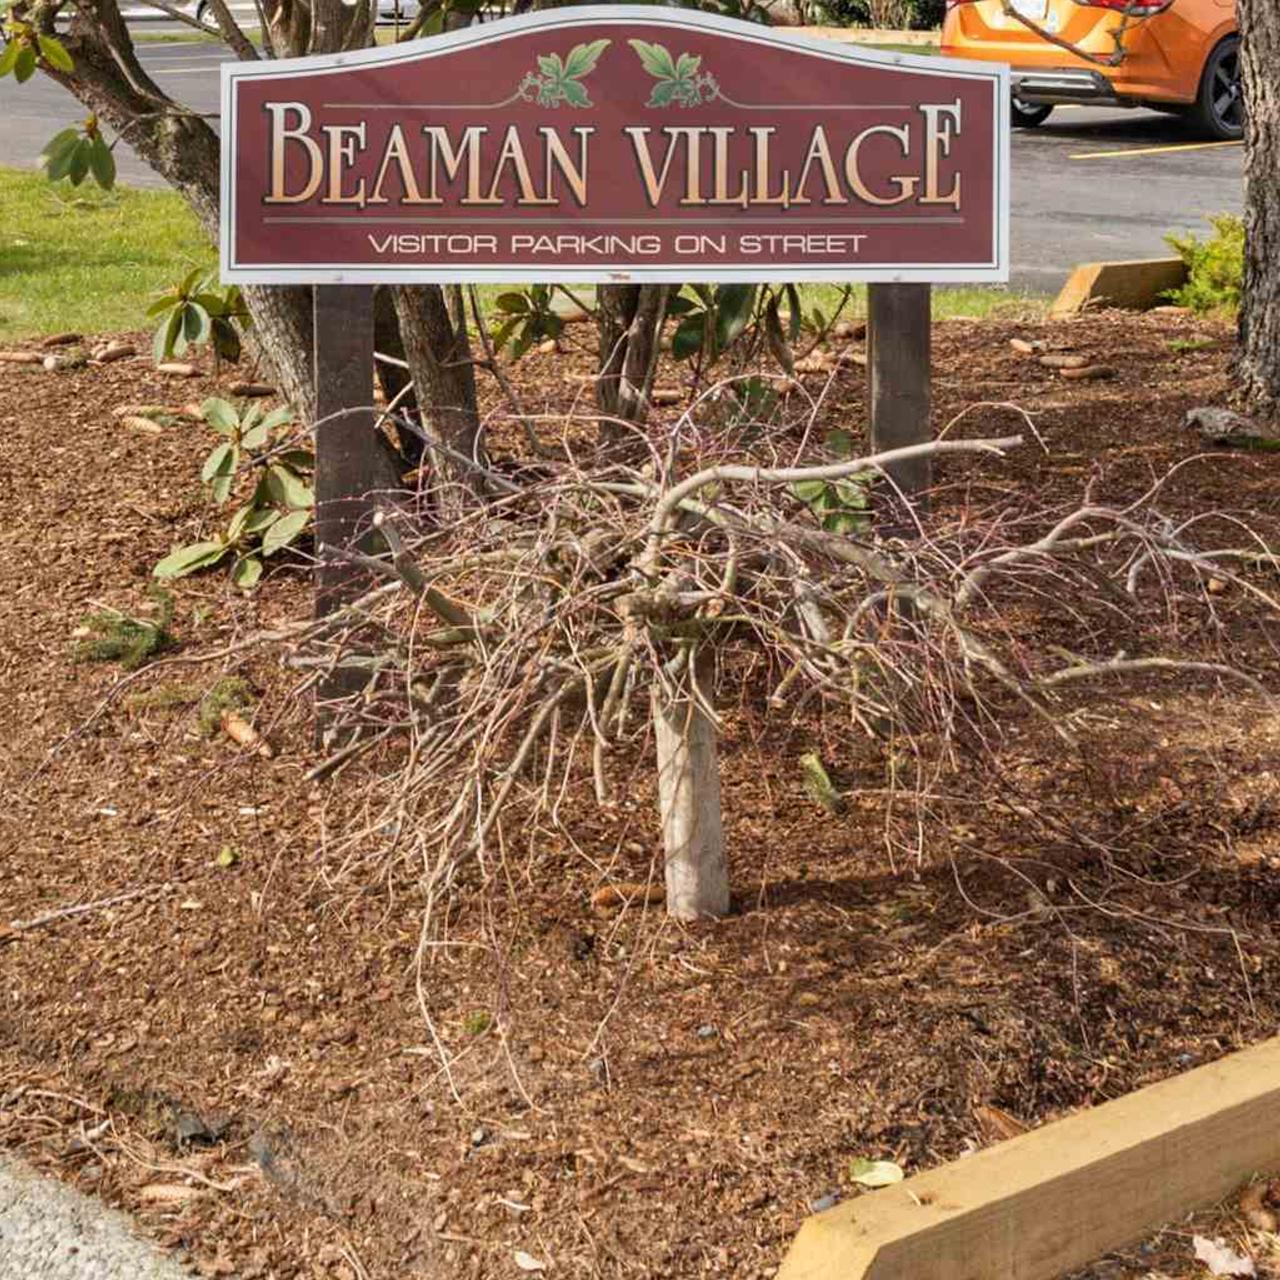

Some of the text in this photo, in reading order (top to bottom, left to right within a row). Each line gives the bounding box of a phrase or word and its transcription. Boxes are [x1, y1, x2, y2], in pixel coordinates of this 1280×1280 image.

[263, 97, 963, 211] BEAMAN VILLAGE
[368, 234, 869, 254] VISITOR PARKING ON STREET
